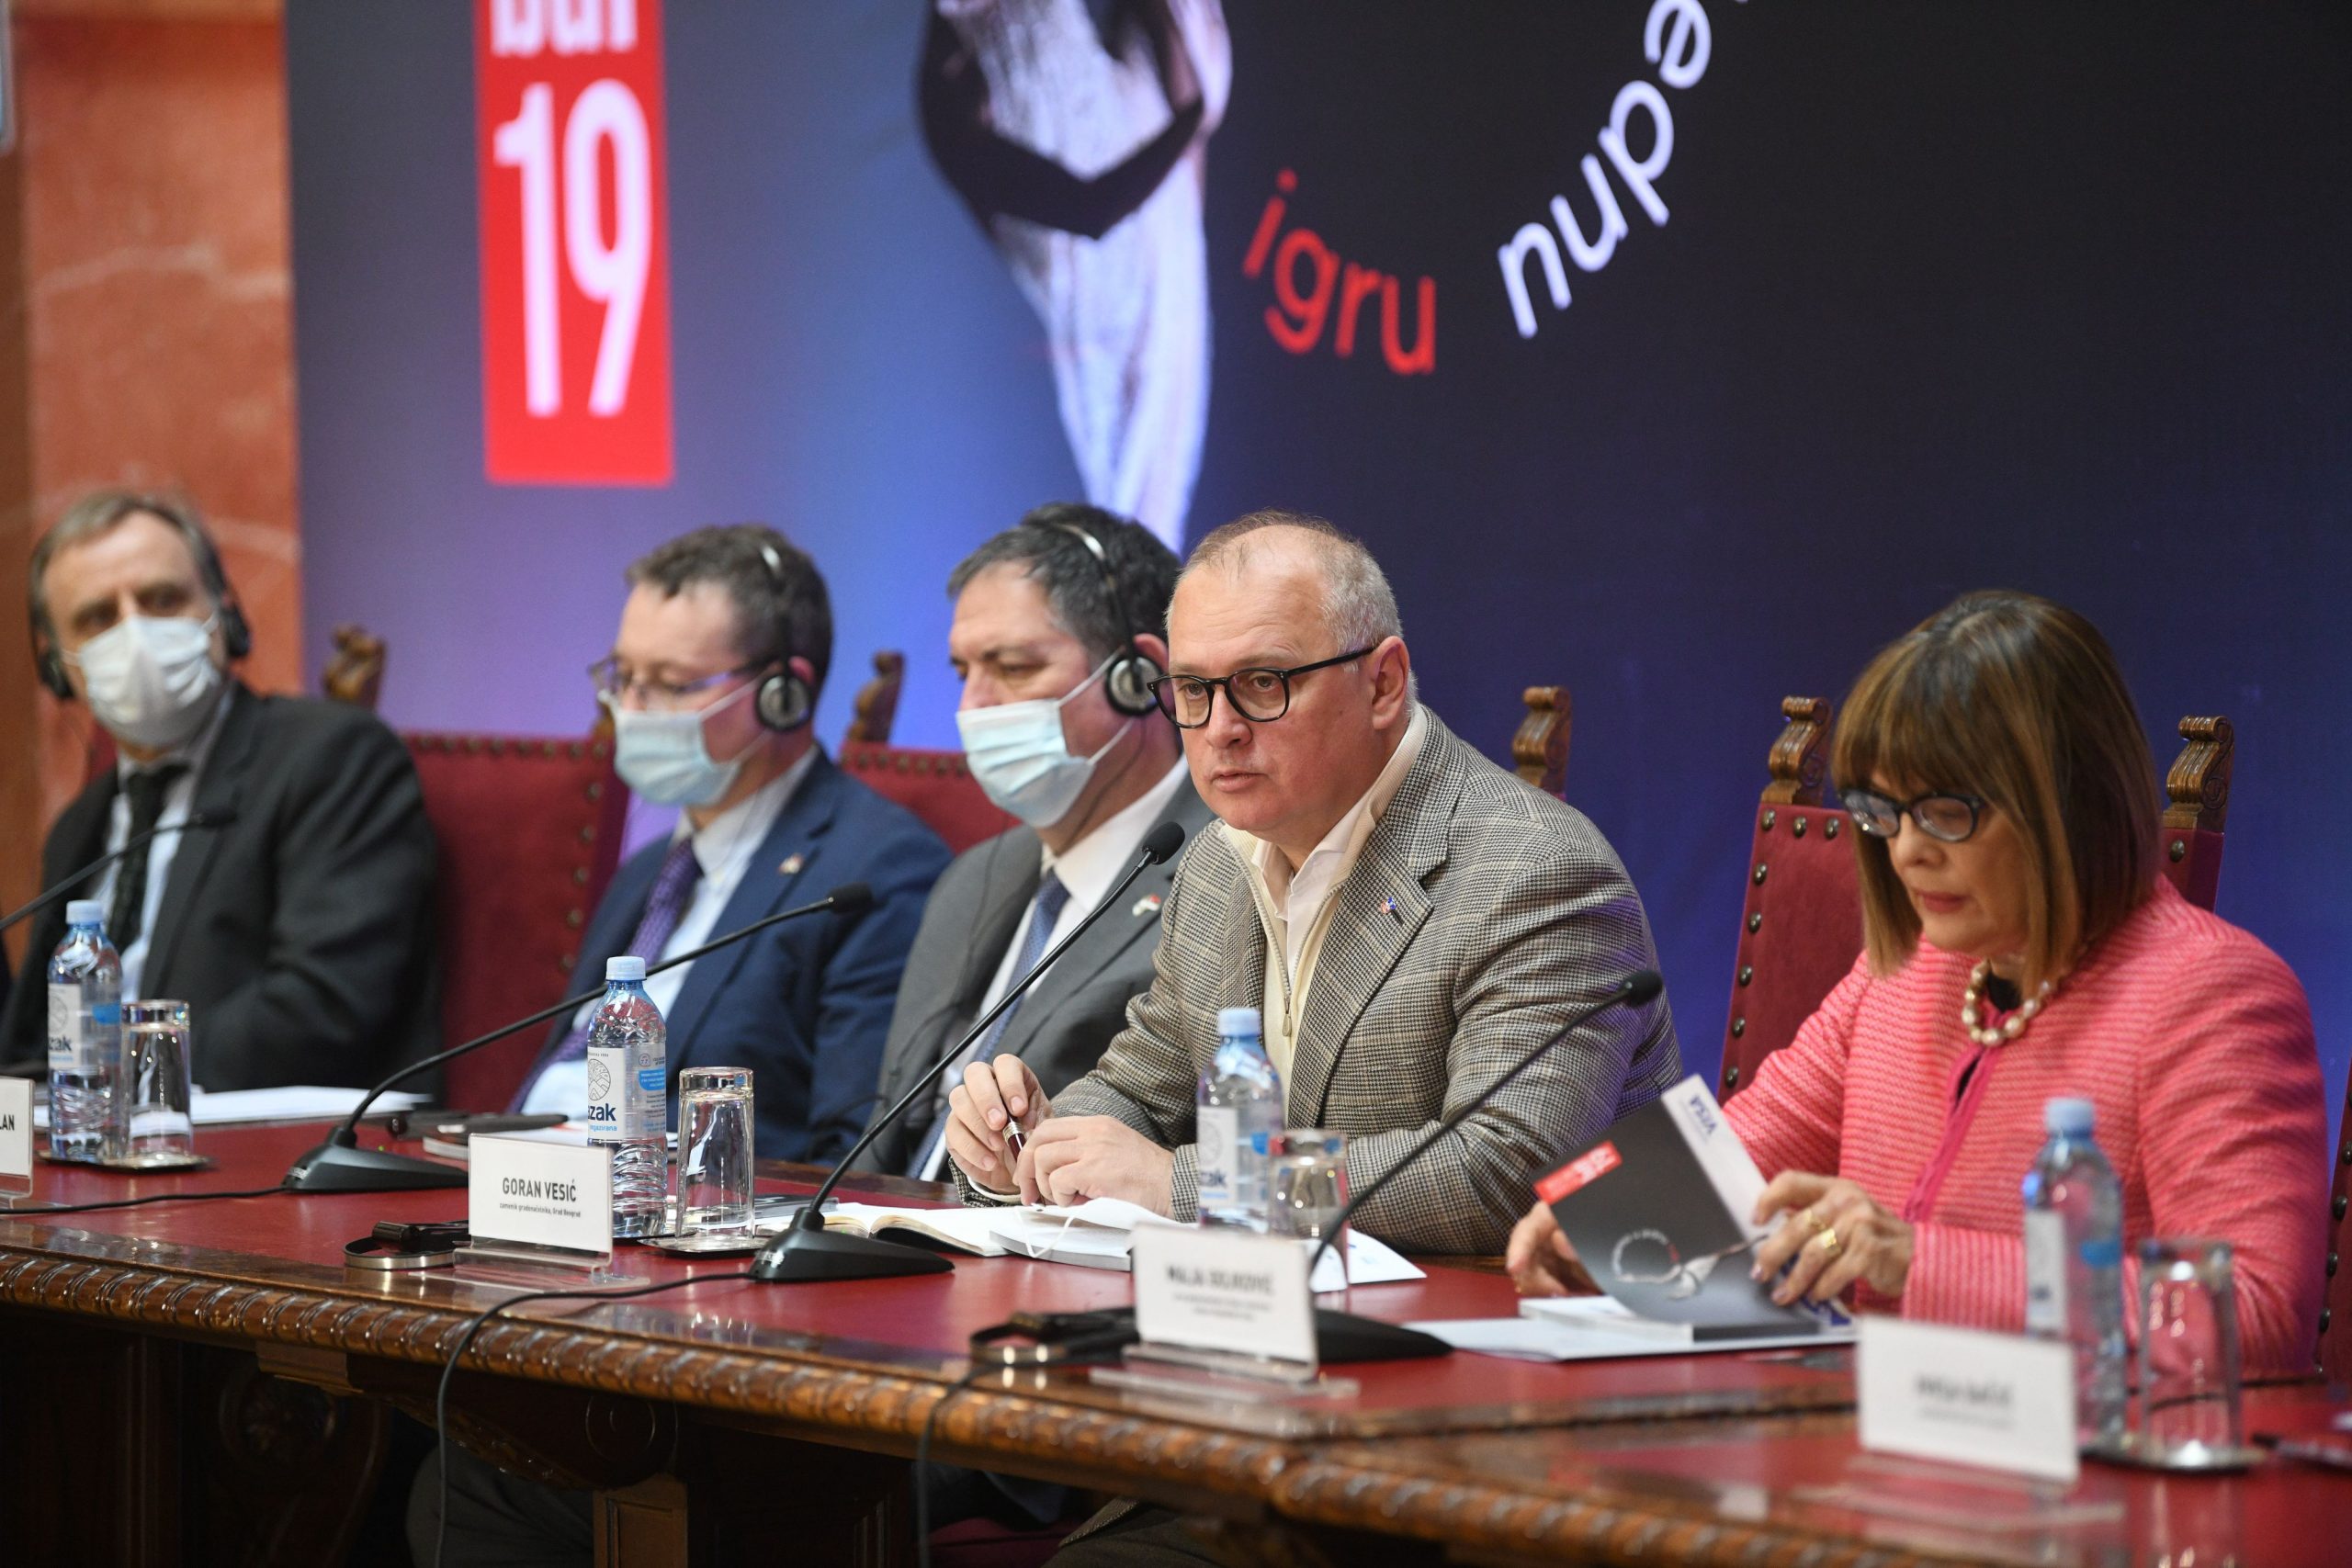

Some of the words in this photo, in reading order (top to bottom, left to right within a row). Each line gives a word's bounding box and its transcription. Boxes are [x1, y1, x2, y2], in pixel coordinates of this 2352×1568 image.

[493, 77, 652, 419] 19
[1242, 168, 1436, 376] igru
[1498, 0, 1748, 338] ednu
[503, 1177, 541, 1199] GORAN
[544, 1179, 577, 1202] VESIĆ
[588, 1102, 616, 1122] zak
